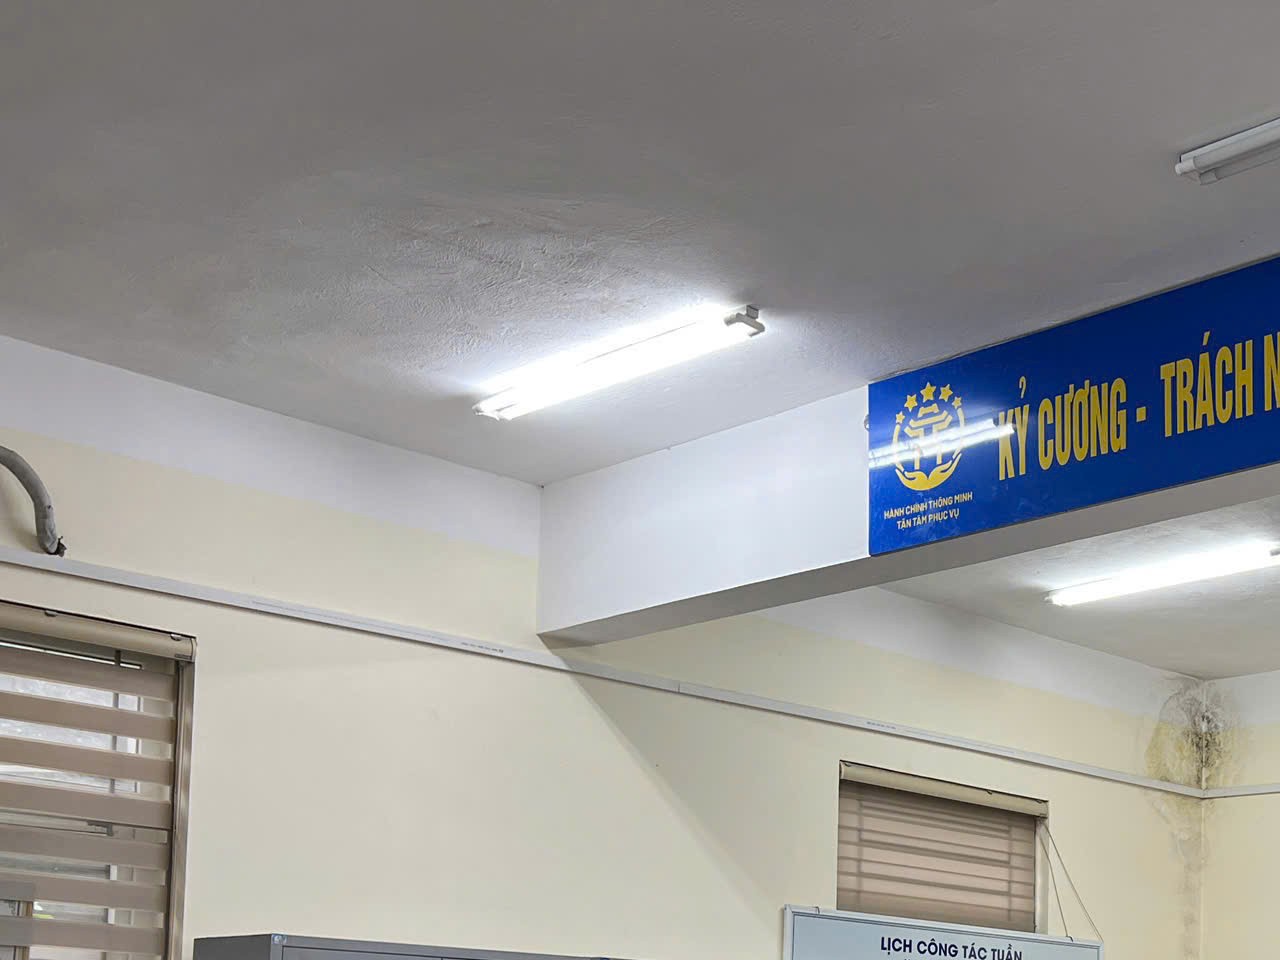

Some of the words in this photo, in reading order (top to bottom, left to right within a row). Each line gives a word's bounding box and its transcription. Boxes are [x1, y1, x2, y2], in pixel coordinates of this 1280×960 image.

[1038, 378, 1127, 472] CƯƠNG
[1160, 332, 1254, 438] TRÁCH
[880, 936, 913, 955] LỊCH
[916, 938, 959, 958] CÔNG
[961, 942, 988, 960] TÁC
